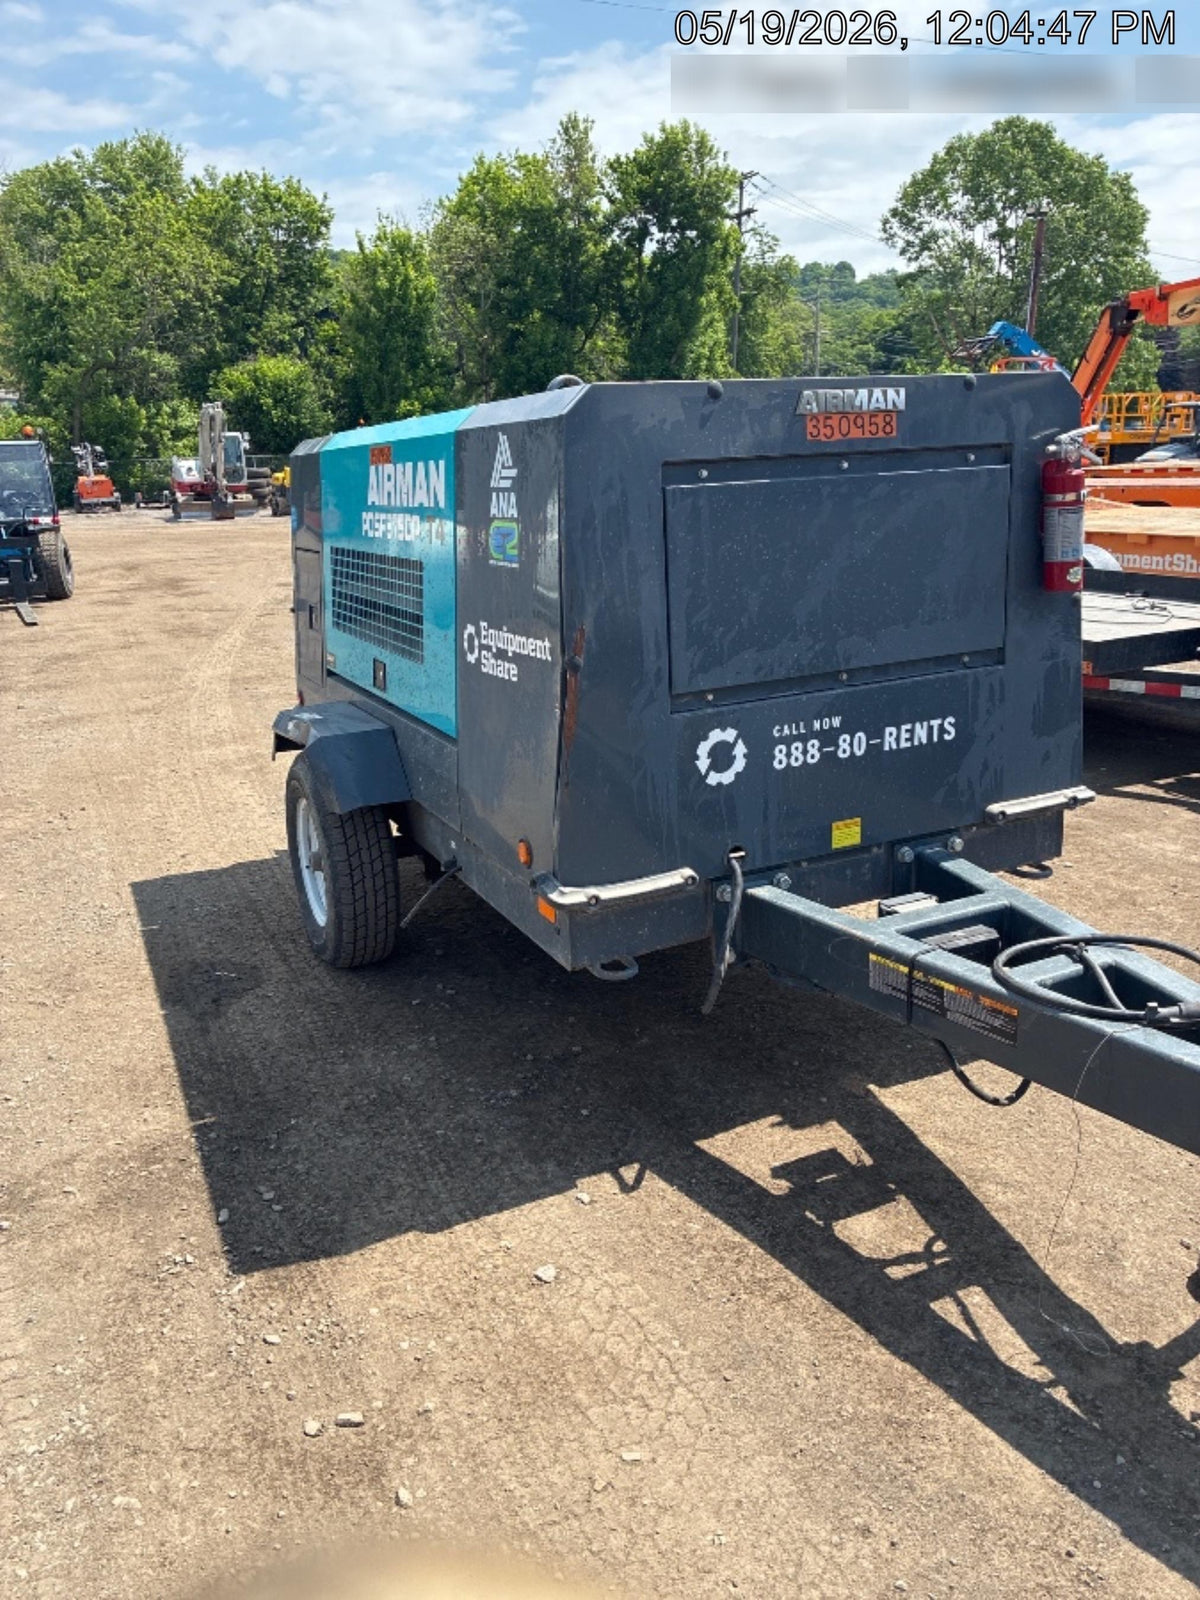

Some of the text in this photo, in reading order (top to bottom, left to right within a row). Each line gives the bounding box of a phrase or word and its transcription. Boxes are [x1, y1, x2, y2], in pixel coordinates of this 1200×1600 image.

[796, 387, 906, 414] AIRMAN
[808, 413, 895, 439] 350958
[367, 460, 445, 509] AIRMAN
[490, 492, 518, 518] ANA
[479, 621, 552, 662] Equipment
[481, 651, 518, 682] Share
[773, 715, 842, 737] CALL NOW
[773, 716, 956, 770] 888-80-RENTS
